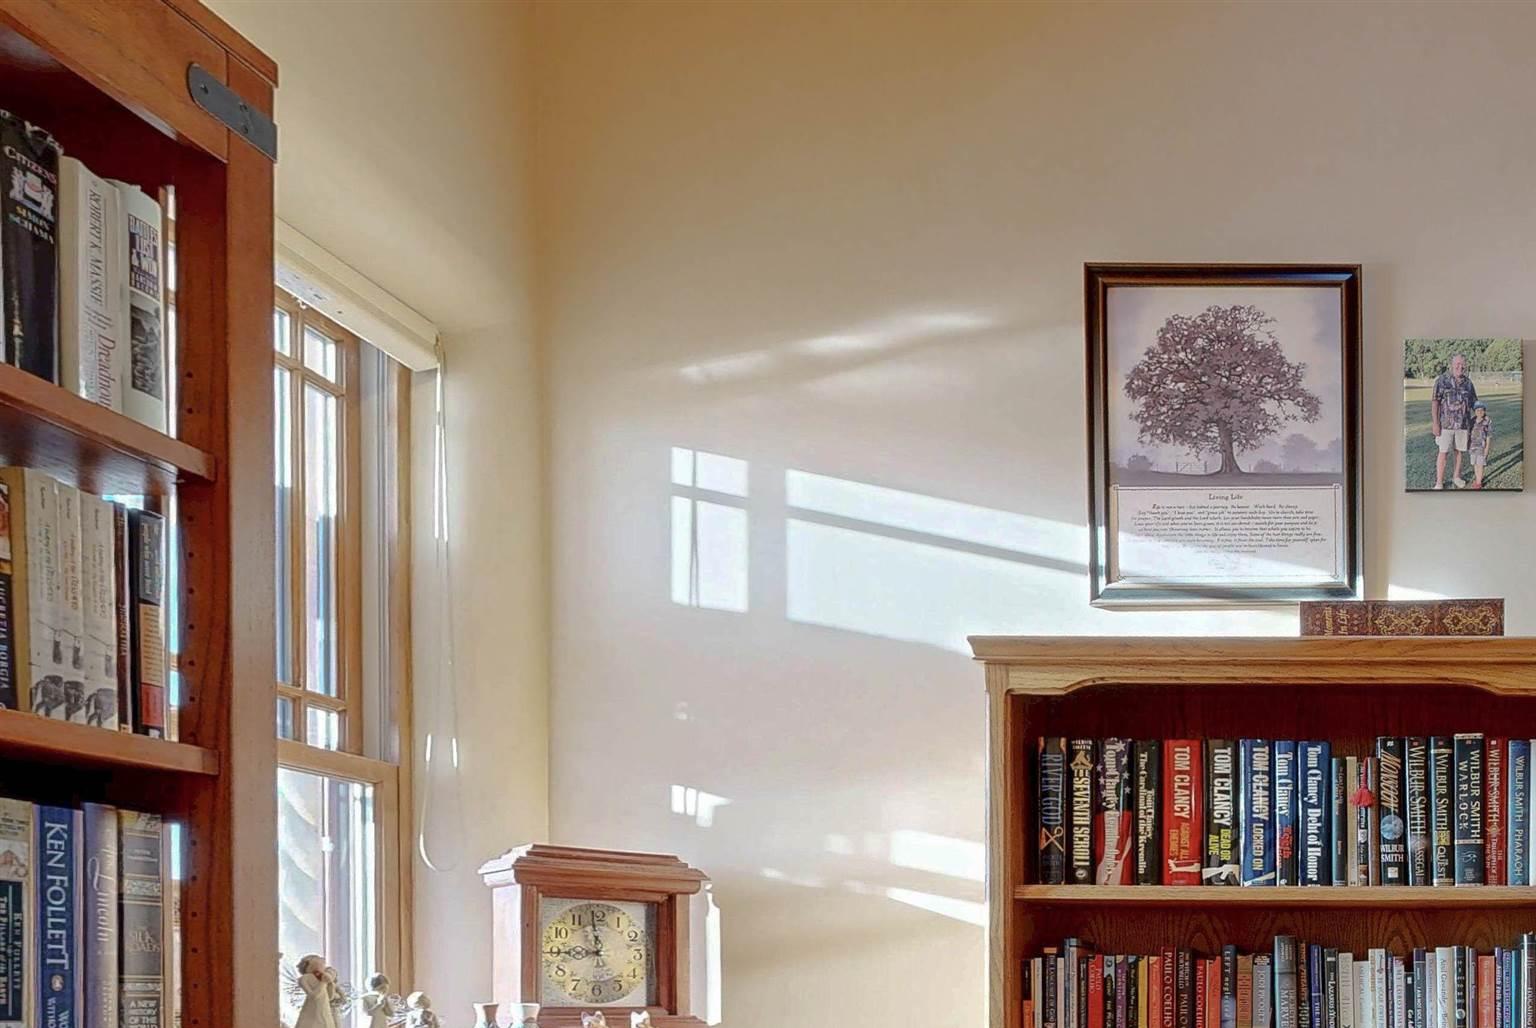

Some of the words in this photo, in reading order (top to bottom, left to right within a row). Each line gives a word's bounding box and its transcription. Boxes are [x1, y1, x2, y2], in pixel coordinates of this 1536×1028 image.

[4, 145, 57, 186] CITIZENS
[8, 213, 54, 245] SCHAMA
[1208, 493, 1230, 501] Living
[1231, 493, 1243, 501] Life
[1174, 747, 1190, 770] TOM
[1214, 748, 1231, 773] TOM
[1470, 750, 1479, 795] WILBUR
[1515, 756, 1525, 790] WILBUR
[1041, 753, 1062, 795] RIVER
[1041, 797, 1061, 824] GOD
[1174, 775, 1190, 818] CLANCY
[1214, 778, 1231, 826] CLANCY
[1459, 761, 1468, 830] WARLOCK
[1515, 792, 1525, 822] SMITH
[1470, 801, 1480, 838] SMITH
[44, 821, 65, 868] KEN
[1514, 829, 1524, 876] PHARAOH
[13, 912, 23, 936] KEN
[45, 874, 69, 970] FOLLETT
[554, 927, 568, 939] 10
[572, 914, 581, 926] 11
[616, 917, 620, 928] 1
[627, 930, 638, 942] 2
[13, 939, 23, 990] FOLLETT
[550, 946, 561, 957] 9
[633, 949, 643, 961] 3
[555, 965, 566, 977] 8
[629, 968, 637, 979] 4
[1164, 952, 1172, 983] PAULO
[571, 979, 581, 991] 7
[592, 985, 601, 997] 6
[613, 980, 622, 992] 5
[1164, 986, 1172, 1027] COELHO
[1179, 994, 1188, 1024] PAULO
